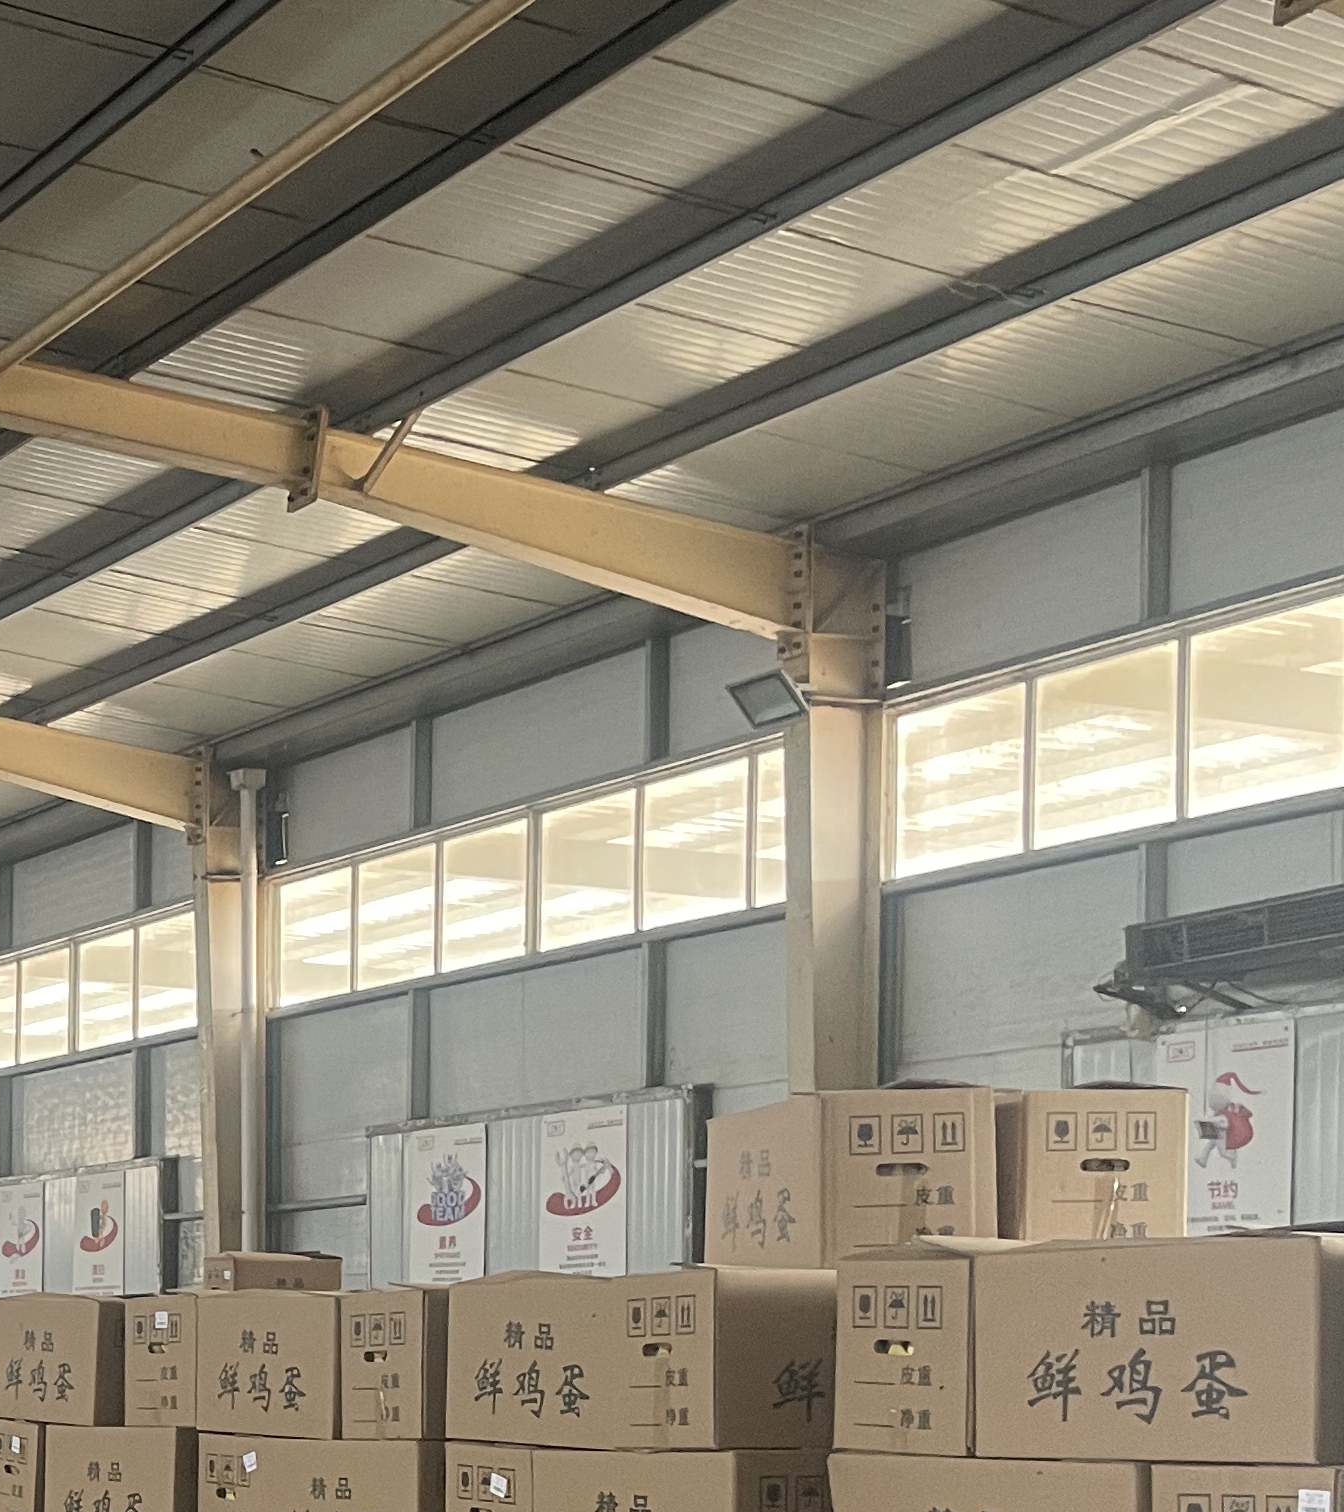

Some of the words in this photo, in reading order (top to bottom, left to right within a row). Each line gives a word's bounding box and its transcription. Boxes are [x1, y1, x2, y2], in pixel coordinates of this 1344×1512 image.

[916, 1185, 955, 1206] 皮重
[1207, 1180, 1238, 1199] 节约
[722, 1187, 795, 1250] 鲜鸡蛋
[571, 1225, 593, 1241] 安全
[1081, 1299, 1177, 1339] 精品
[23, 1329, 55, 1353] 精品
[240, 1329, 279, 1355] 精品
[503, 1320, 555, 1351] 精品
[4, 1357, 76, 1403] 鲜鸡蛋
[217, 1361, 307, 1413] 鲜鸡蛋
[474, 1356, 590, 1419] 鲜鸡蛋
[900, 1365, 933, 1388] 皮重
[1027, 1347, 1249, 1425] 鲜鸡蛋
[899, 1408, 932, 1431] 净重
[86, 1460, 123, 1484] 精品
[310, 1476, 353, 1502] 精品
